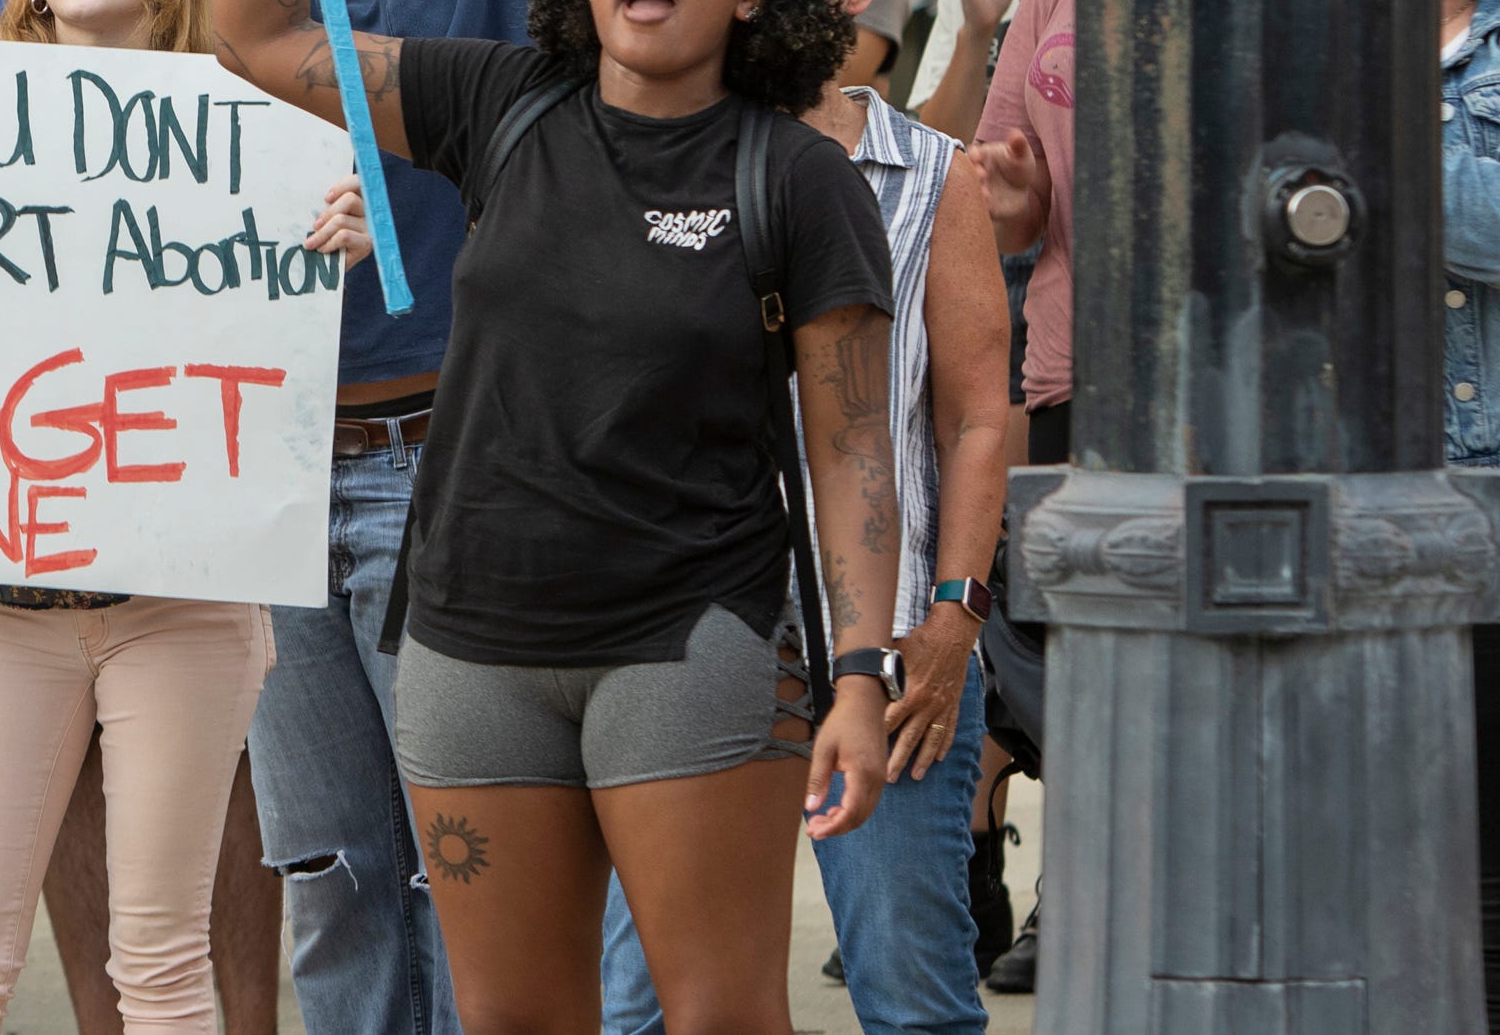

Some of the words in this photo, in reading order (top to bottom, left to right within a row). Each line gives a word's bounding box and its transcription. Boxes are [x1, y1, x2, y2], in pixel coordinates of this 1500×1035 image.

[66, 69, 271, 194] DONT
[102, 198, 340, 301] Abortion
[0, 347, 286, 482] GET
